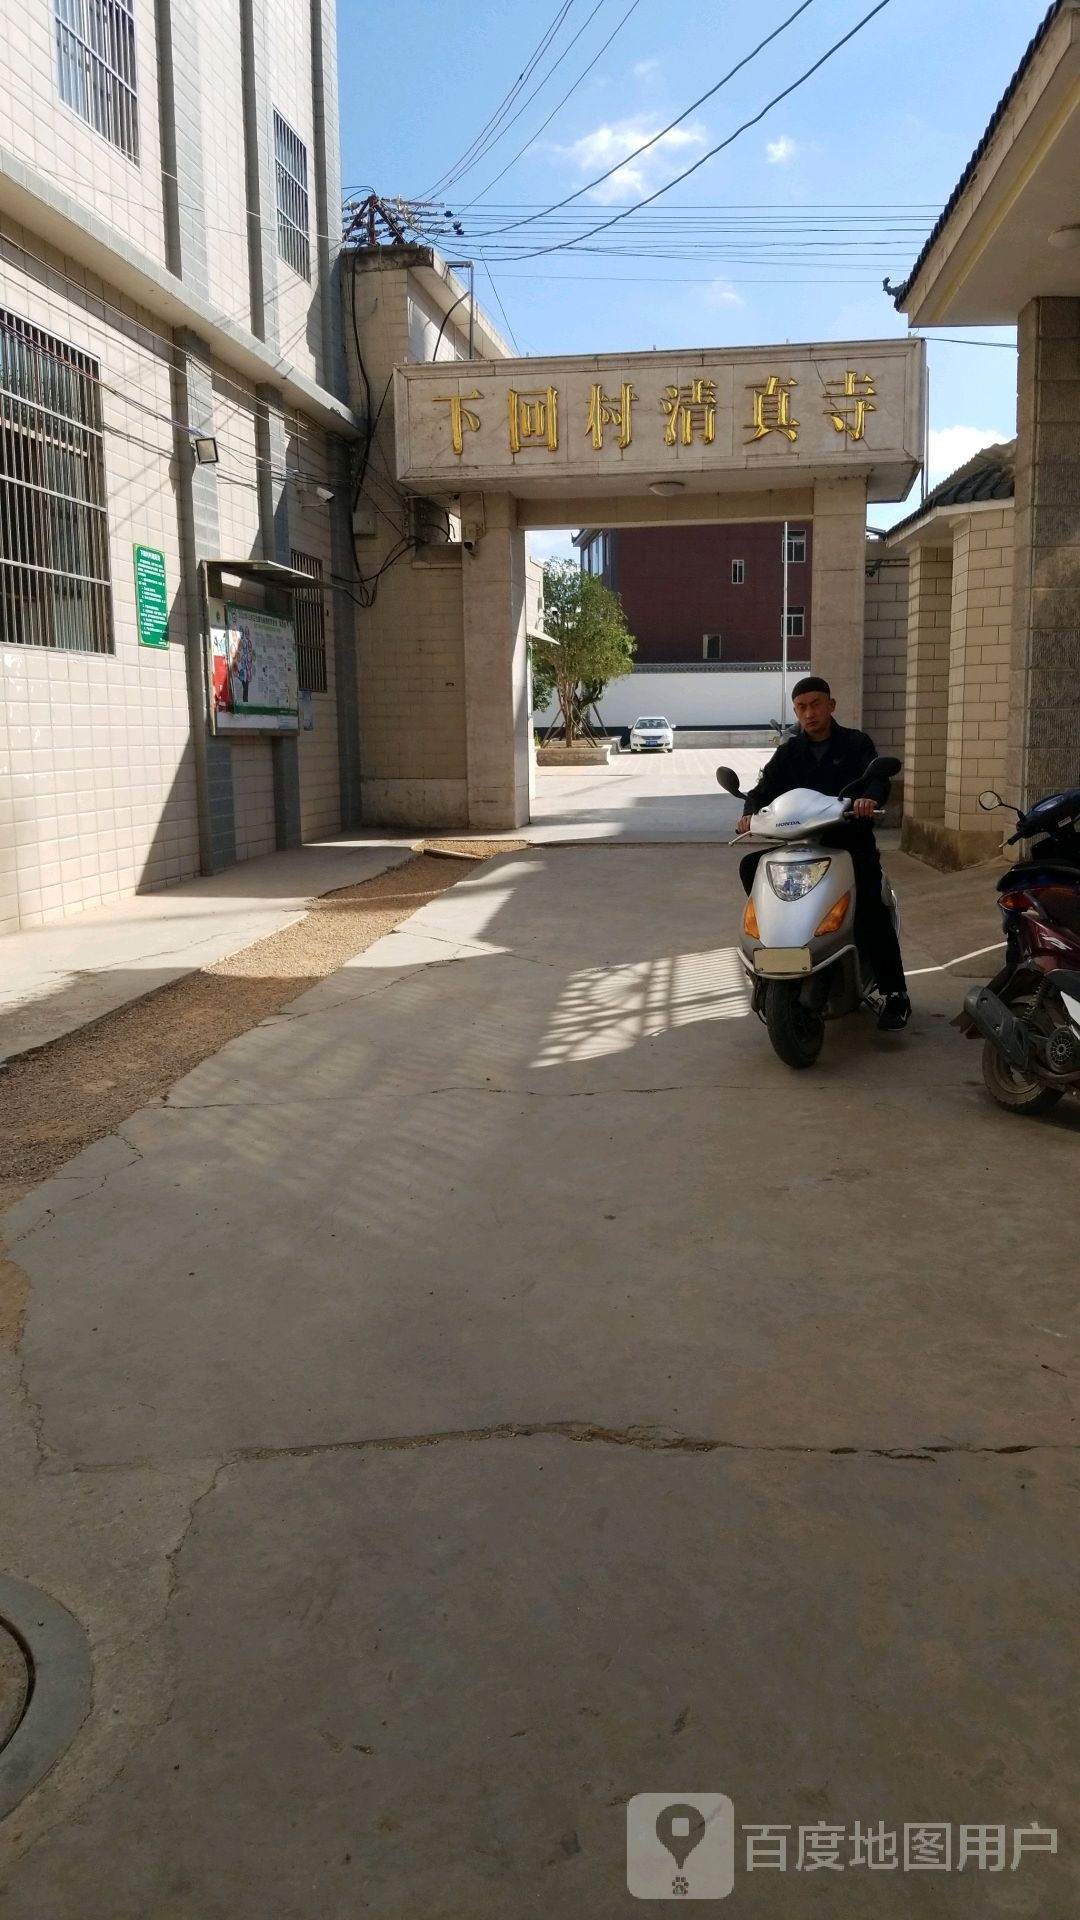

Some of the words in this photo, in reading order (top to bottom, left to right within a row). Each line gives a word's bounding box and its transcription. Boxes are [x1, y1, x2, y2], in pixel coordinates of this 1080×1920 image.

[431, 370, 877, 455] 下回村清真寺
[775, 820, 801, 828] HONDA
